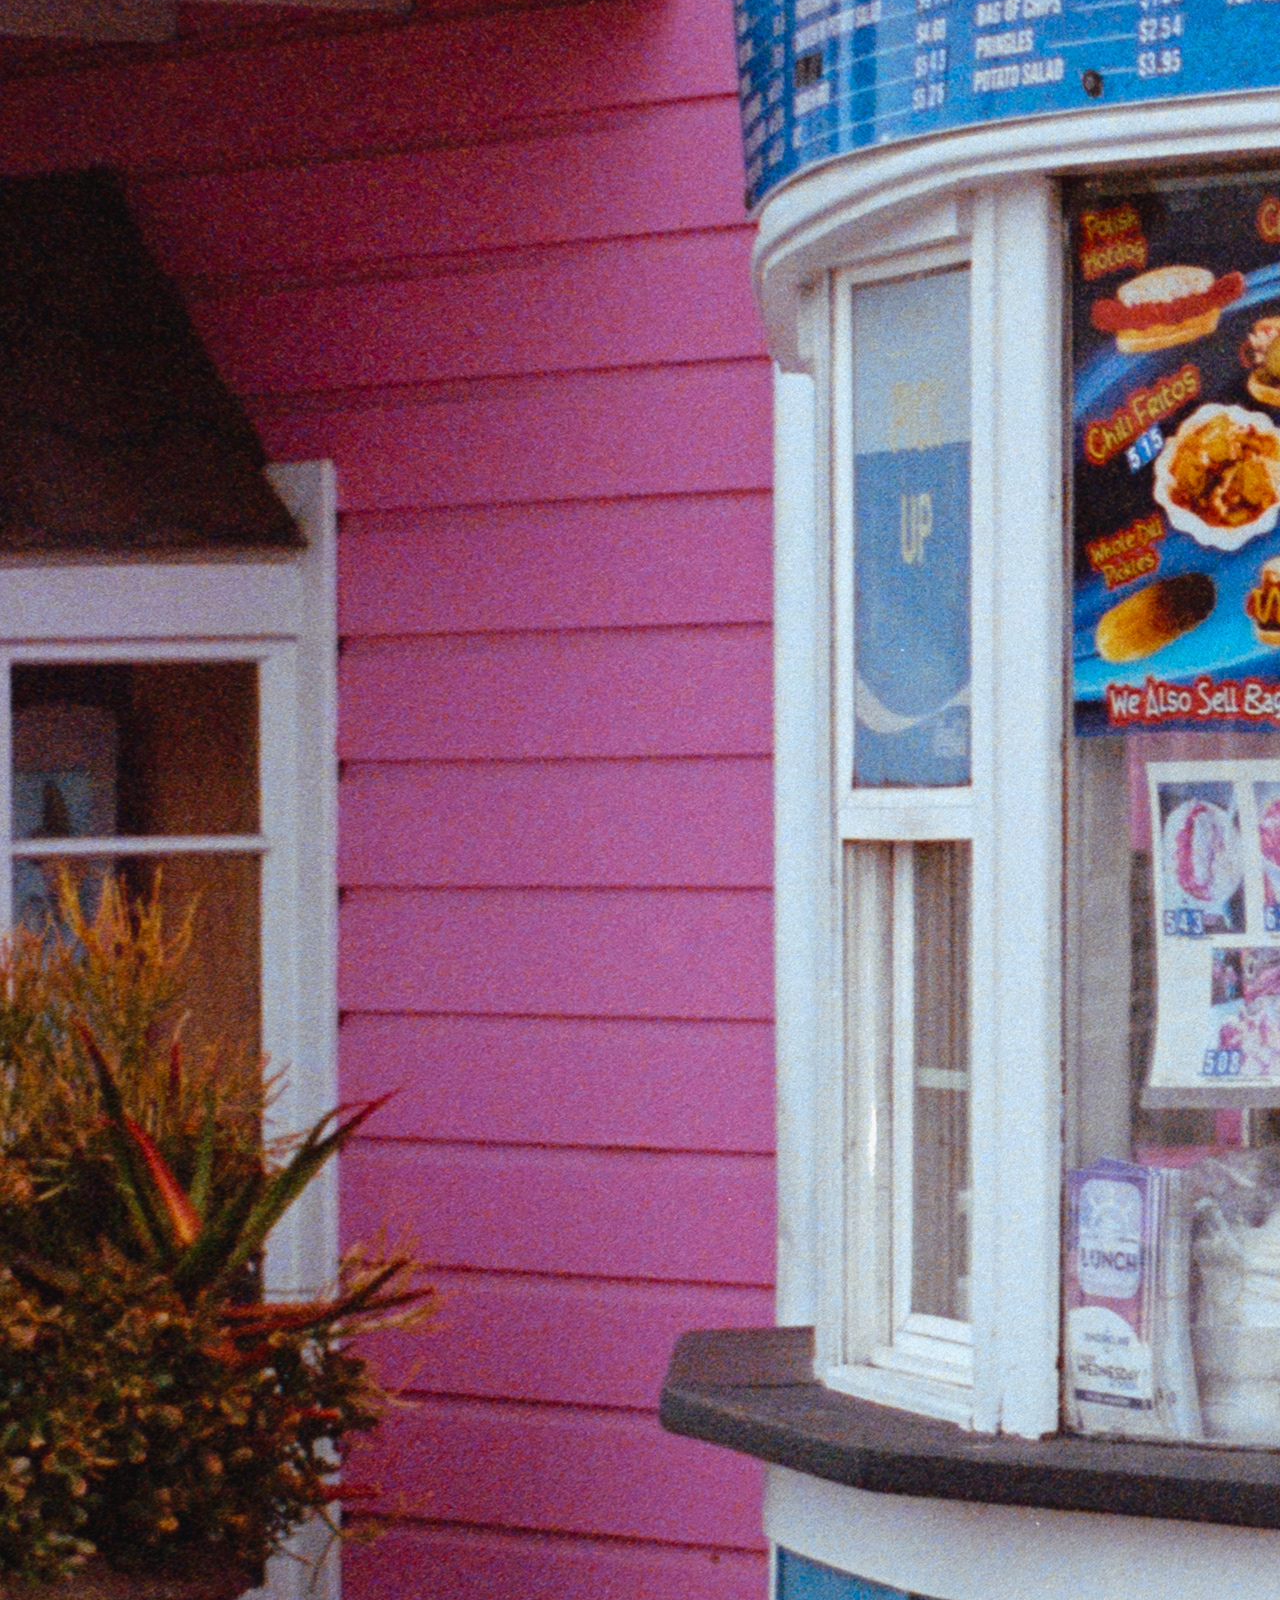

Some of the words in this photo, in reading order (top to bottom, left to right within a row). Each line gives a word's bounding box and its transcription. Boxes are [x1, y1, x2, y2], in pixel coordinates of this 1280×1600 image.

[1110, 689, 1140, 717] We
[1146, 684, 1191, 717] Also
[1197, 682, 1239, 715] Sell
[1203, 1050, 1241, 1075] 508
